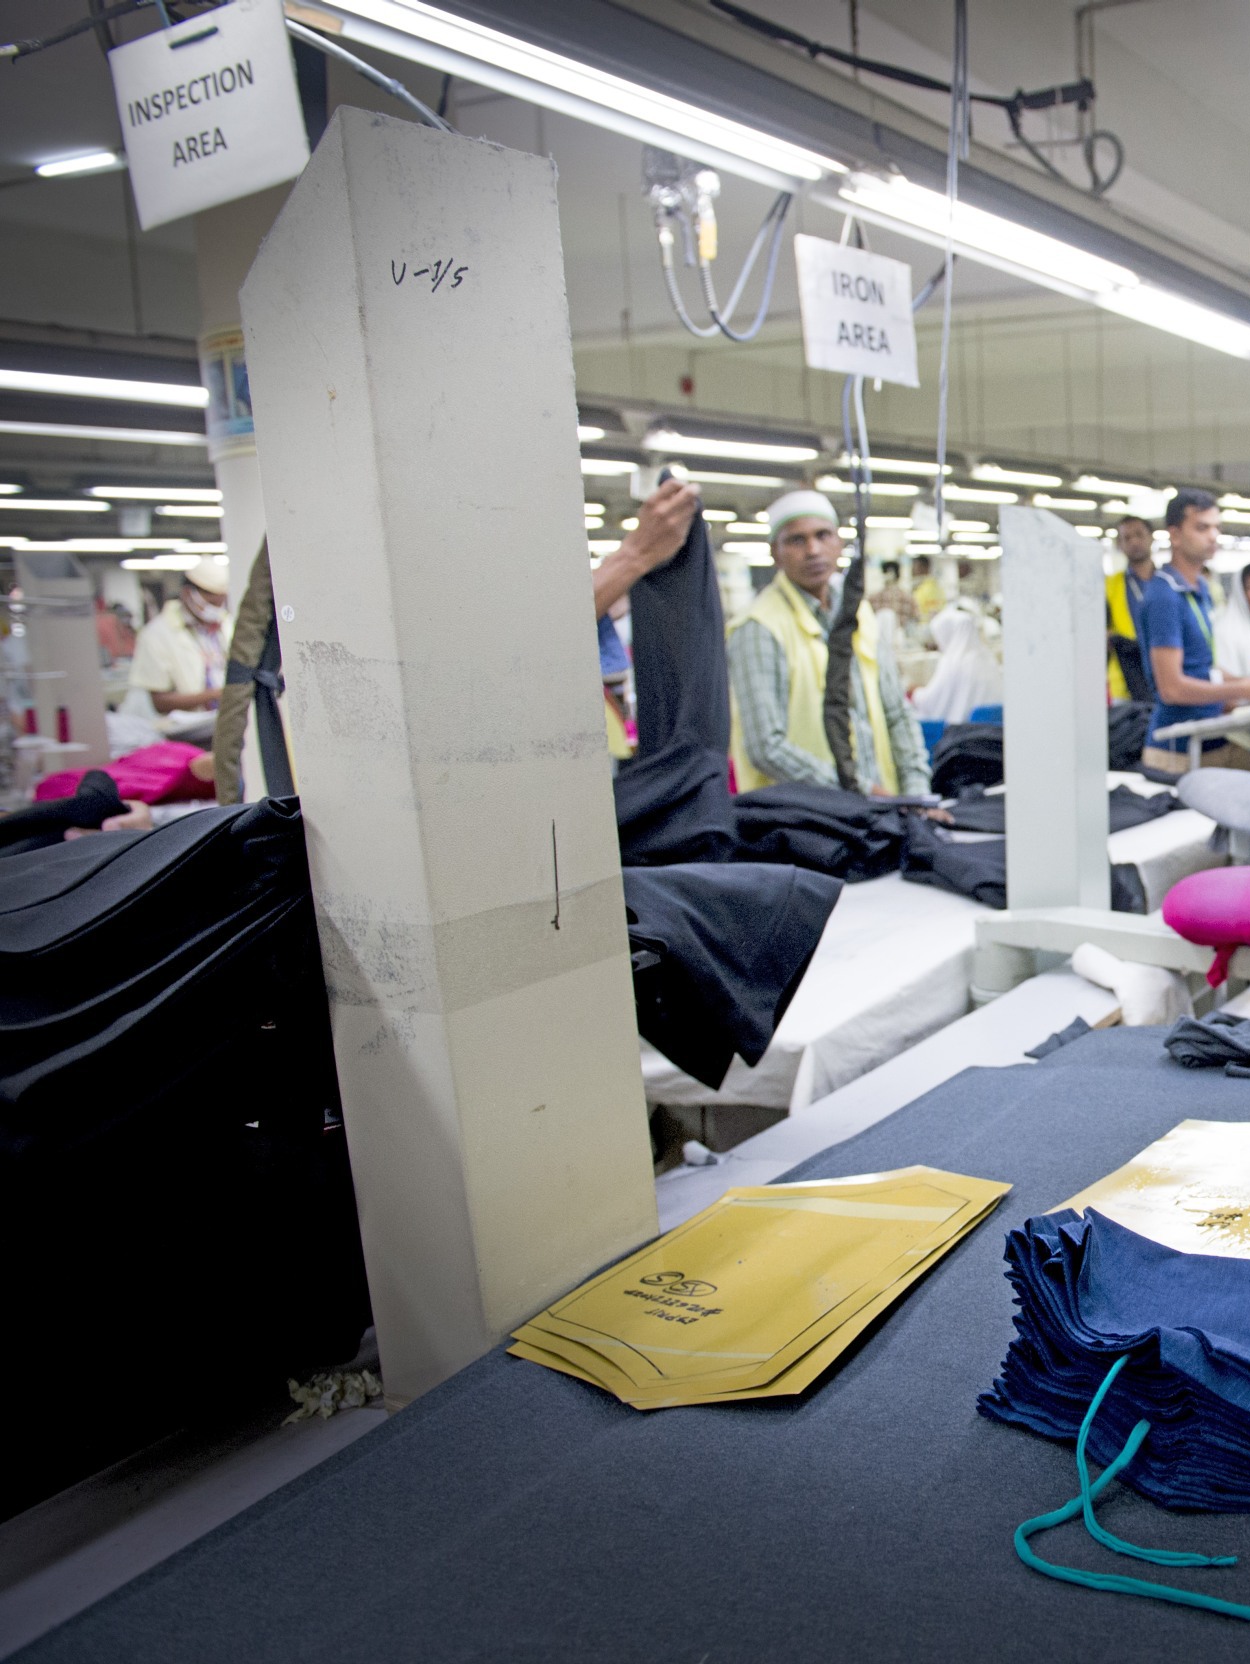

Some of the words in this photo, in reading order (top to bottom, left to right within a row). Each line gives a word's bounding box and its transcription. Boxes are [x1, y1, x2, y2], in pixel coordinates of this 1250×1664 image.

[128, 59, 254, 127] INSPECTION
[172, 126, 229, 168] AREA
[831, 270, 885, 306] IRON
[837, 321, 892, 355] AREA
